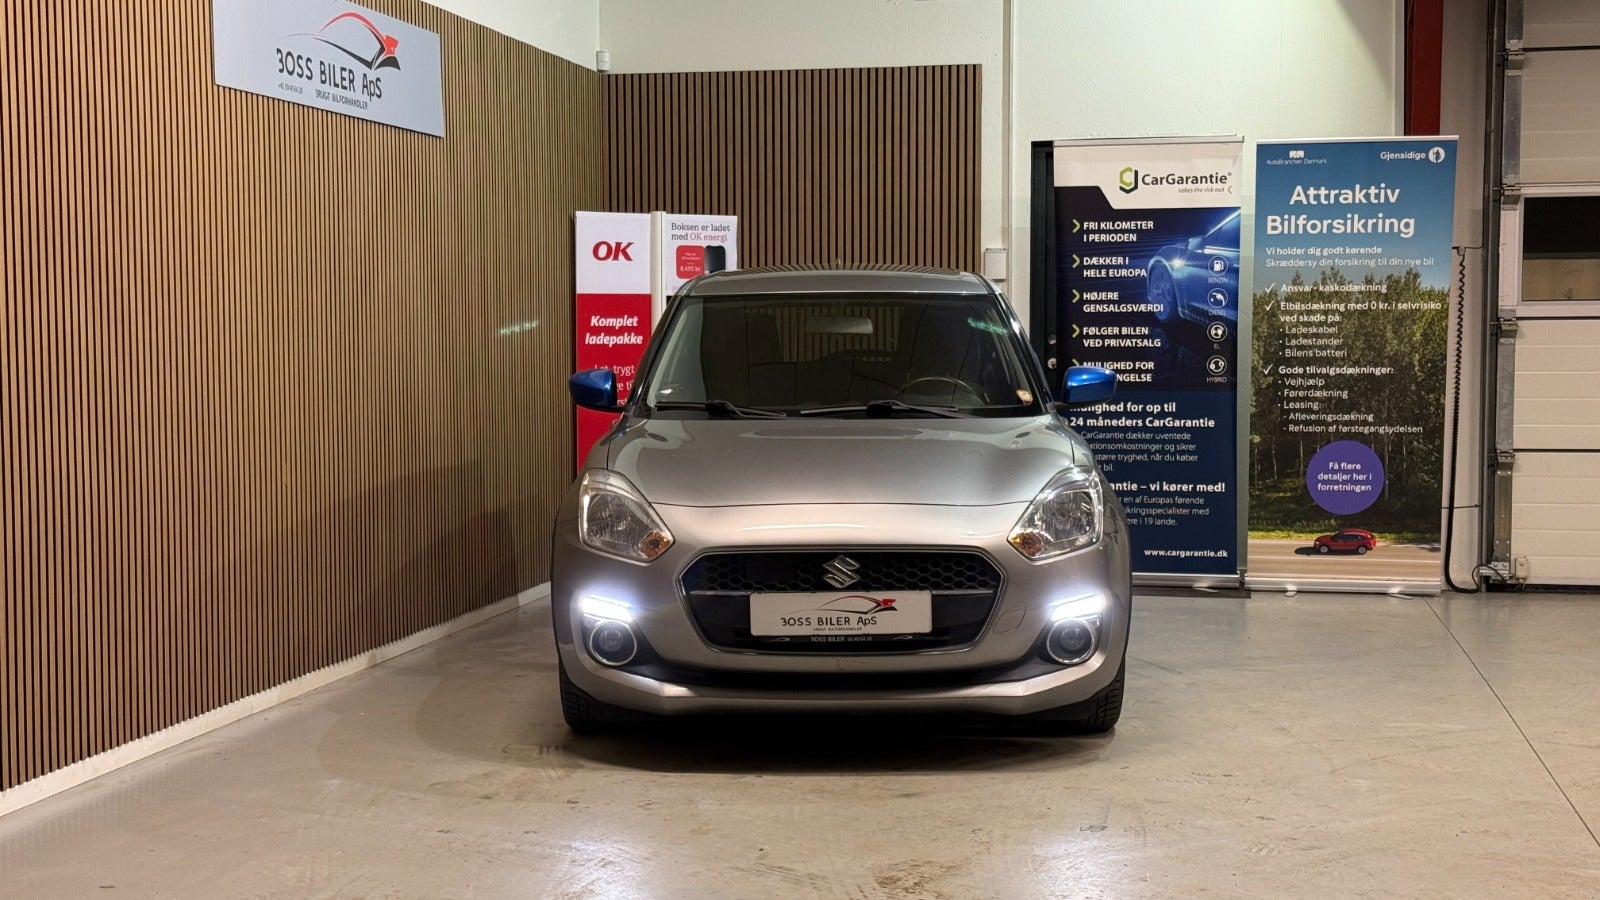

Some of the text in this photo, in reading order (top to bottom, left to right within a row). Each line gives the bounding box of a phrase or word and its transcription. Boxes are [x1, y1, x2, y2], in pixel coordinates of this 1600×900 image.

[320, 60, 356, 93] BILER
[362, 73, 382, 101] ApS
[1380, 152, 1426, 161] Gjensidige
[1290, 183, 1400, 205] Attraktiv
[1084, 221, 1154, 230] FRI KILOMETER
[1267, 213, 1415, 238] Bilforsikring
[704, 234, 728, 243] energi
[1084, 234, 1137, 242] I PERIODEN
[592, 241, 634, 261] OK
[1266, 246, 1382, 257] Vi holder dig godt kørende
[1084, 257, 1129, 266] DÆKKER I
[1266, 259, 1318, 269] Skræddersy
[1319, 259, 1333, 267] din
[1335, 258, 1376, 268] forsikring
[1378, 258, 1387, 266] til
[1389, 258, 1403, 266] din
[1084, 269, 1147, 278] HELE EUROPA
[1281, 284, 1387, 294] Ansvar- kaskodækning
[1084, 292, 1119, 300] HØJERE
[1083, 304, 1164, 313] GENSALGSVÆRDI
[1281, 303, 1345, 312] Elbilsdækning
[1348, 302, 1368, 310] med
[1379, 302, 1391, 310] kr.
[1398, 302, 1441, 310] selvrisiko
[591, 316, 638, 330] Komplet
[1280, 314, 1342, 323] ved skade på:
[1084, 327, 1148, 336] FØLGER BILEN
[1285, 326, 1338, 334] Ladeskabel
[585, 333, 643, 348] ladepakke
[1084, 339, 1161, 348] VED PRIVATSALG
[1285, 338, 1344, 346] Ladestander
[1316, 349, 1347, 357] batteri
[614, 365, 635, 376] trygt
[1136, 362, 1154, 370] FOR
[1279, 366, 1394, 376] Gode tilvalgsdækninger:
[1117, 374, 1152, 382] NGELSE
[1284, 378, 1325, 388] Vejhjælp
[1284, 390, 1348, 399] Førerdækning
[1127, 402, 1143, 412] for
[1146, 404, 1161, 414] op
[1164, 402, 1176, 412] til
[1284, 401, 1322, 410] Leasing:
[1070, 416, 1215, 428] 24 måneders CarGarantie
[1289, 414, 1374, 422] Afleveringsdækning
[1289, 425, 1423, 434] Refusion af førstegangsydelsen
[1081, 431, 1191, 440] CarGarantie dækker uventede
[1089, 443, 1163, 451] ationsomkostninger
[1150, 453, 1162, 461] når
[1164, 454, 1175, 462] du
[1177, 454, 1198, 462] køber
[1329, 462, 1361, 470] Få flere
[1318, 473, 1350, 482] detaljer
[1353, 473, 1367, 481] her
[1150, 482, 1160, 491] vi
[1163, 482, 1194, 492] kører
[1197, 483, 1226, 492] med!
[1318, 484, 1372, 492] forretningen
[1144, 496, 1174, 505] Europas
[1175, 496, 1204, 505] førende
[1125, 507, 1190, 516] ikringsspecialister
[1144, 549, 1228, 558] www.cargarantie.dk
[818, 617, 851, 626] BILER
[857, 616, 877, 627] ApS
